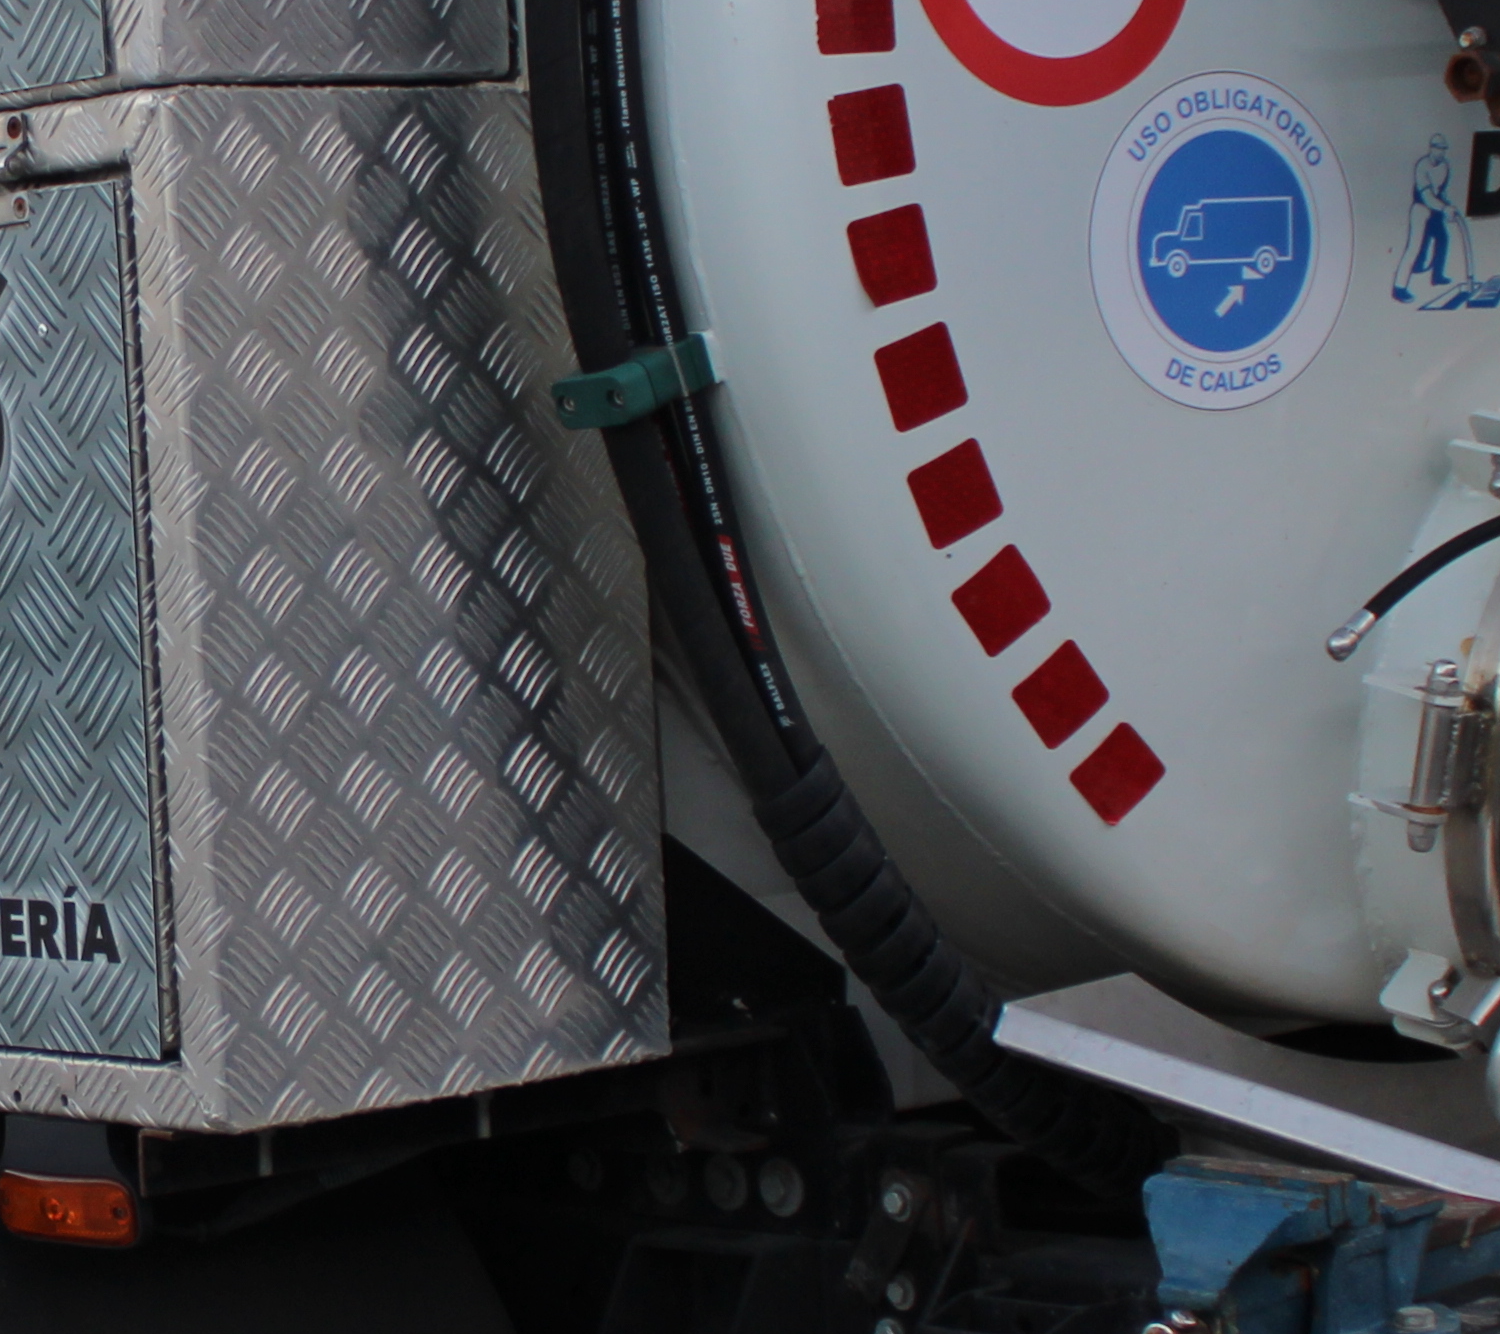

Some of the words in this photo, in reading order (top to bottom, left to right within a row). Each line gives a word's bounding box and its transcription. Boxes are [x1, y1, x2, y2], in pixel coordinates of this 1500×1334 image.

[612, 27, 627, 86] Resistant
[618, 89, 631, 126] Flame
[1127, 111, 1172, 164] USO
[1176, 88, 1323, 167] OBLIGATORIO
[640, 238, 656, 268] 1436
[649, 273, 662, 295] ISO
[1165, 357, 1194, 387] DE
[1200, 353, 1283, 392] CALZOS
[691, 432, 705, 454] DIN
[699, 461, 715, 494] DN10
[709, 501, 723, 525] 2SN
[719, 540, 737, 573] DUE
[731, 580, 754, 629] FORZA
[757, 661, 786, 711] BALFLEX
